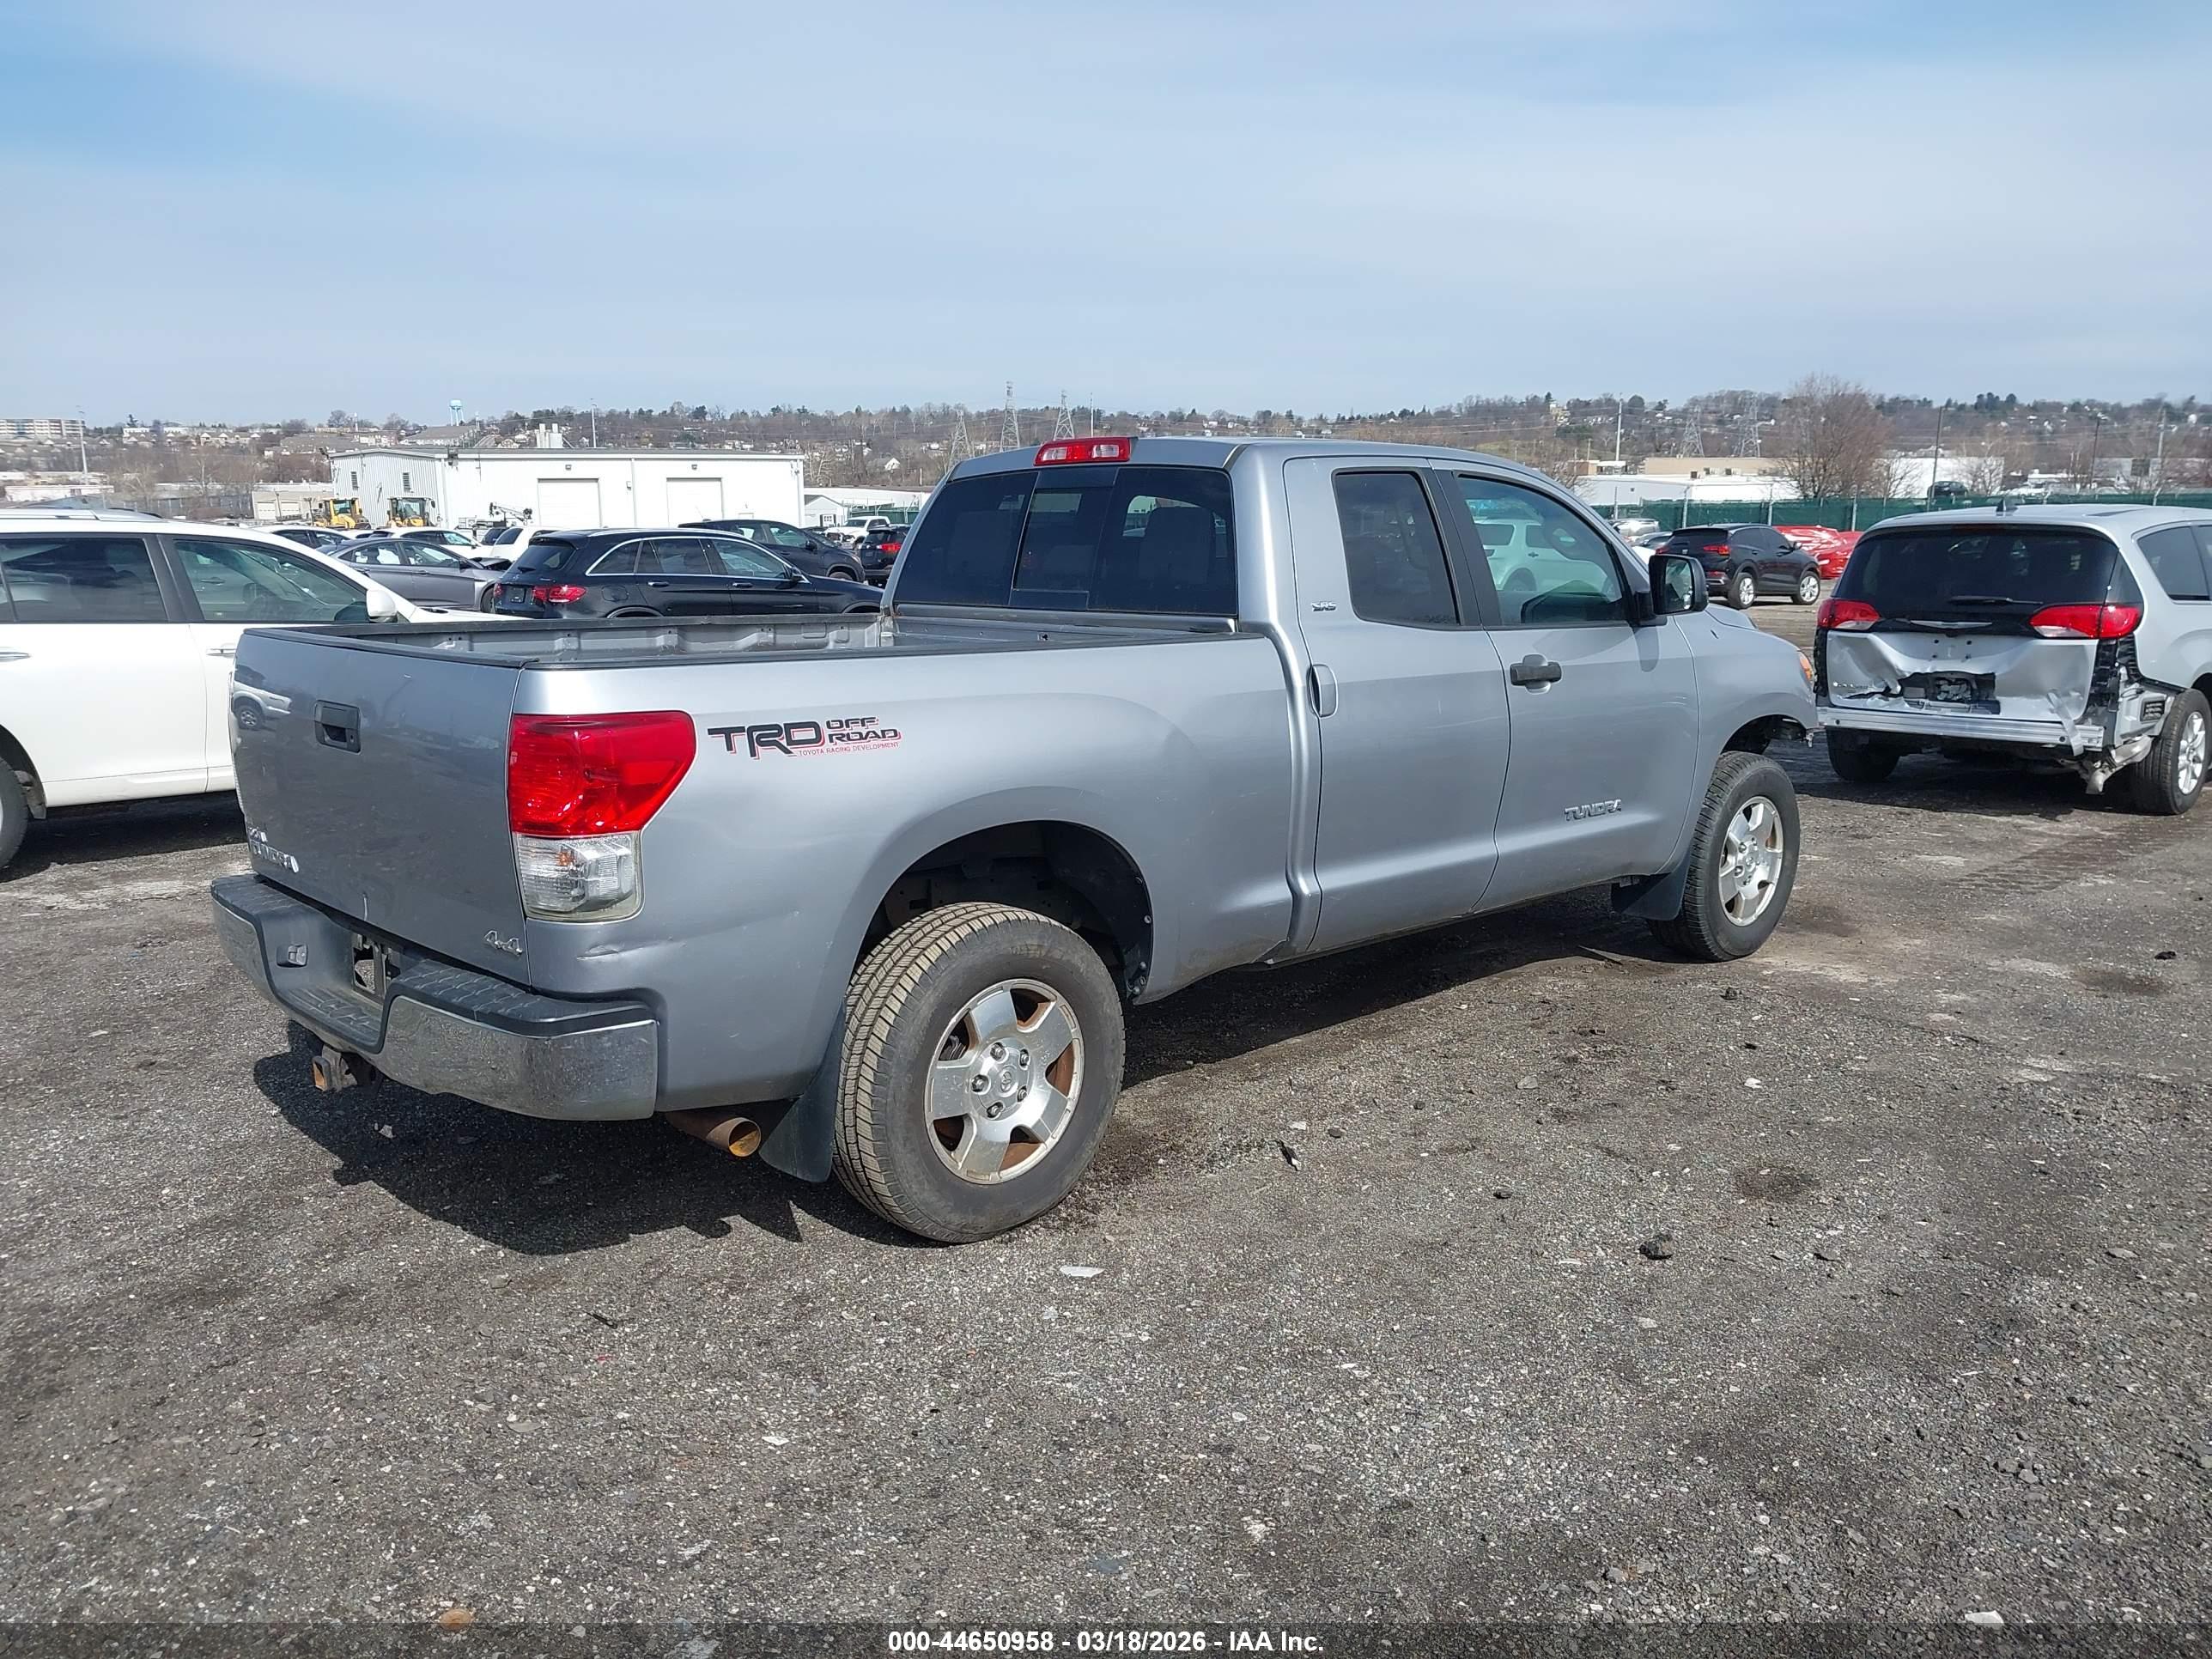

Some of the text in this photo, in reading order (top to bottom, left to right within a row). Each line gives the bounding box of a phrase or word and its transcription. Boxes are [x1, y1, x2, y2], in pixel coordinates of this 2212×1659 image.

[826, 716, 879, 730] OFF
[707, 721, 825, 761] TRD
[828, 728, 902, 746] ROAD
[799, 742, 900, 757] TOYOTA RACING DEVELOPMENT
[1564, 799, 1622, 821] TUNDRA
